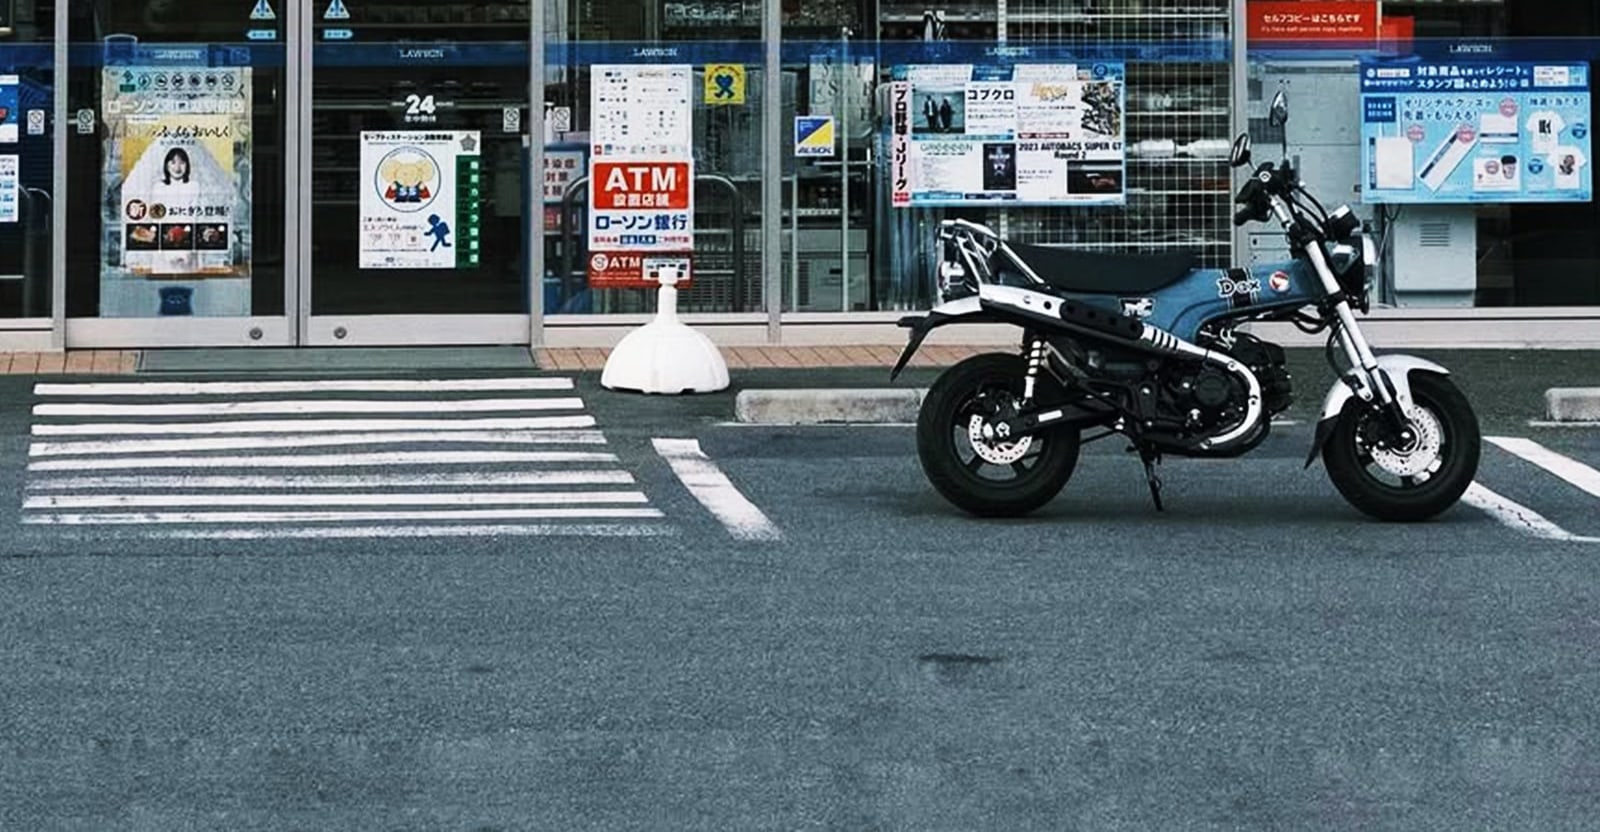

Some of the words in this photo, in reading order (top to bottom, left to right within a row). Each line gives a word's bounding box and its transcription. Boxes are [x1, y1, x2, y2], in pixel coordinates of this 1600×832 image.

[1263, 14, 1361, 23] セルフコピーはこちらです
[399, 49, 444, 58] LAWSON
[967, 89, 1015, 101] コブクロ
[405, 94, 437, 115] 24
[895, 90, 908, 191] プロ野球・Jリーグ
[1019, 142, 1039, 151] 2023
[1041, 142, 1083, 151] AUTOBACS
[1085, 142, 1110, 151] SUPER
[1112, 142, 1123, 151] GT
[1054, 151, 1080, 160] Round
[1081, 151, 1087, 159] 2
[604, 166, 677, 193] ATM
[595, 214, 688, 231] ローソン銀行
[610, 256, 641, 269] ATM
